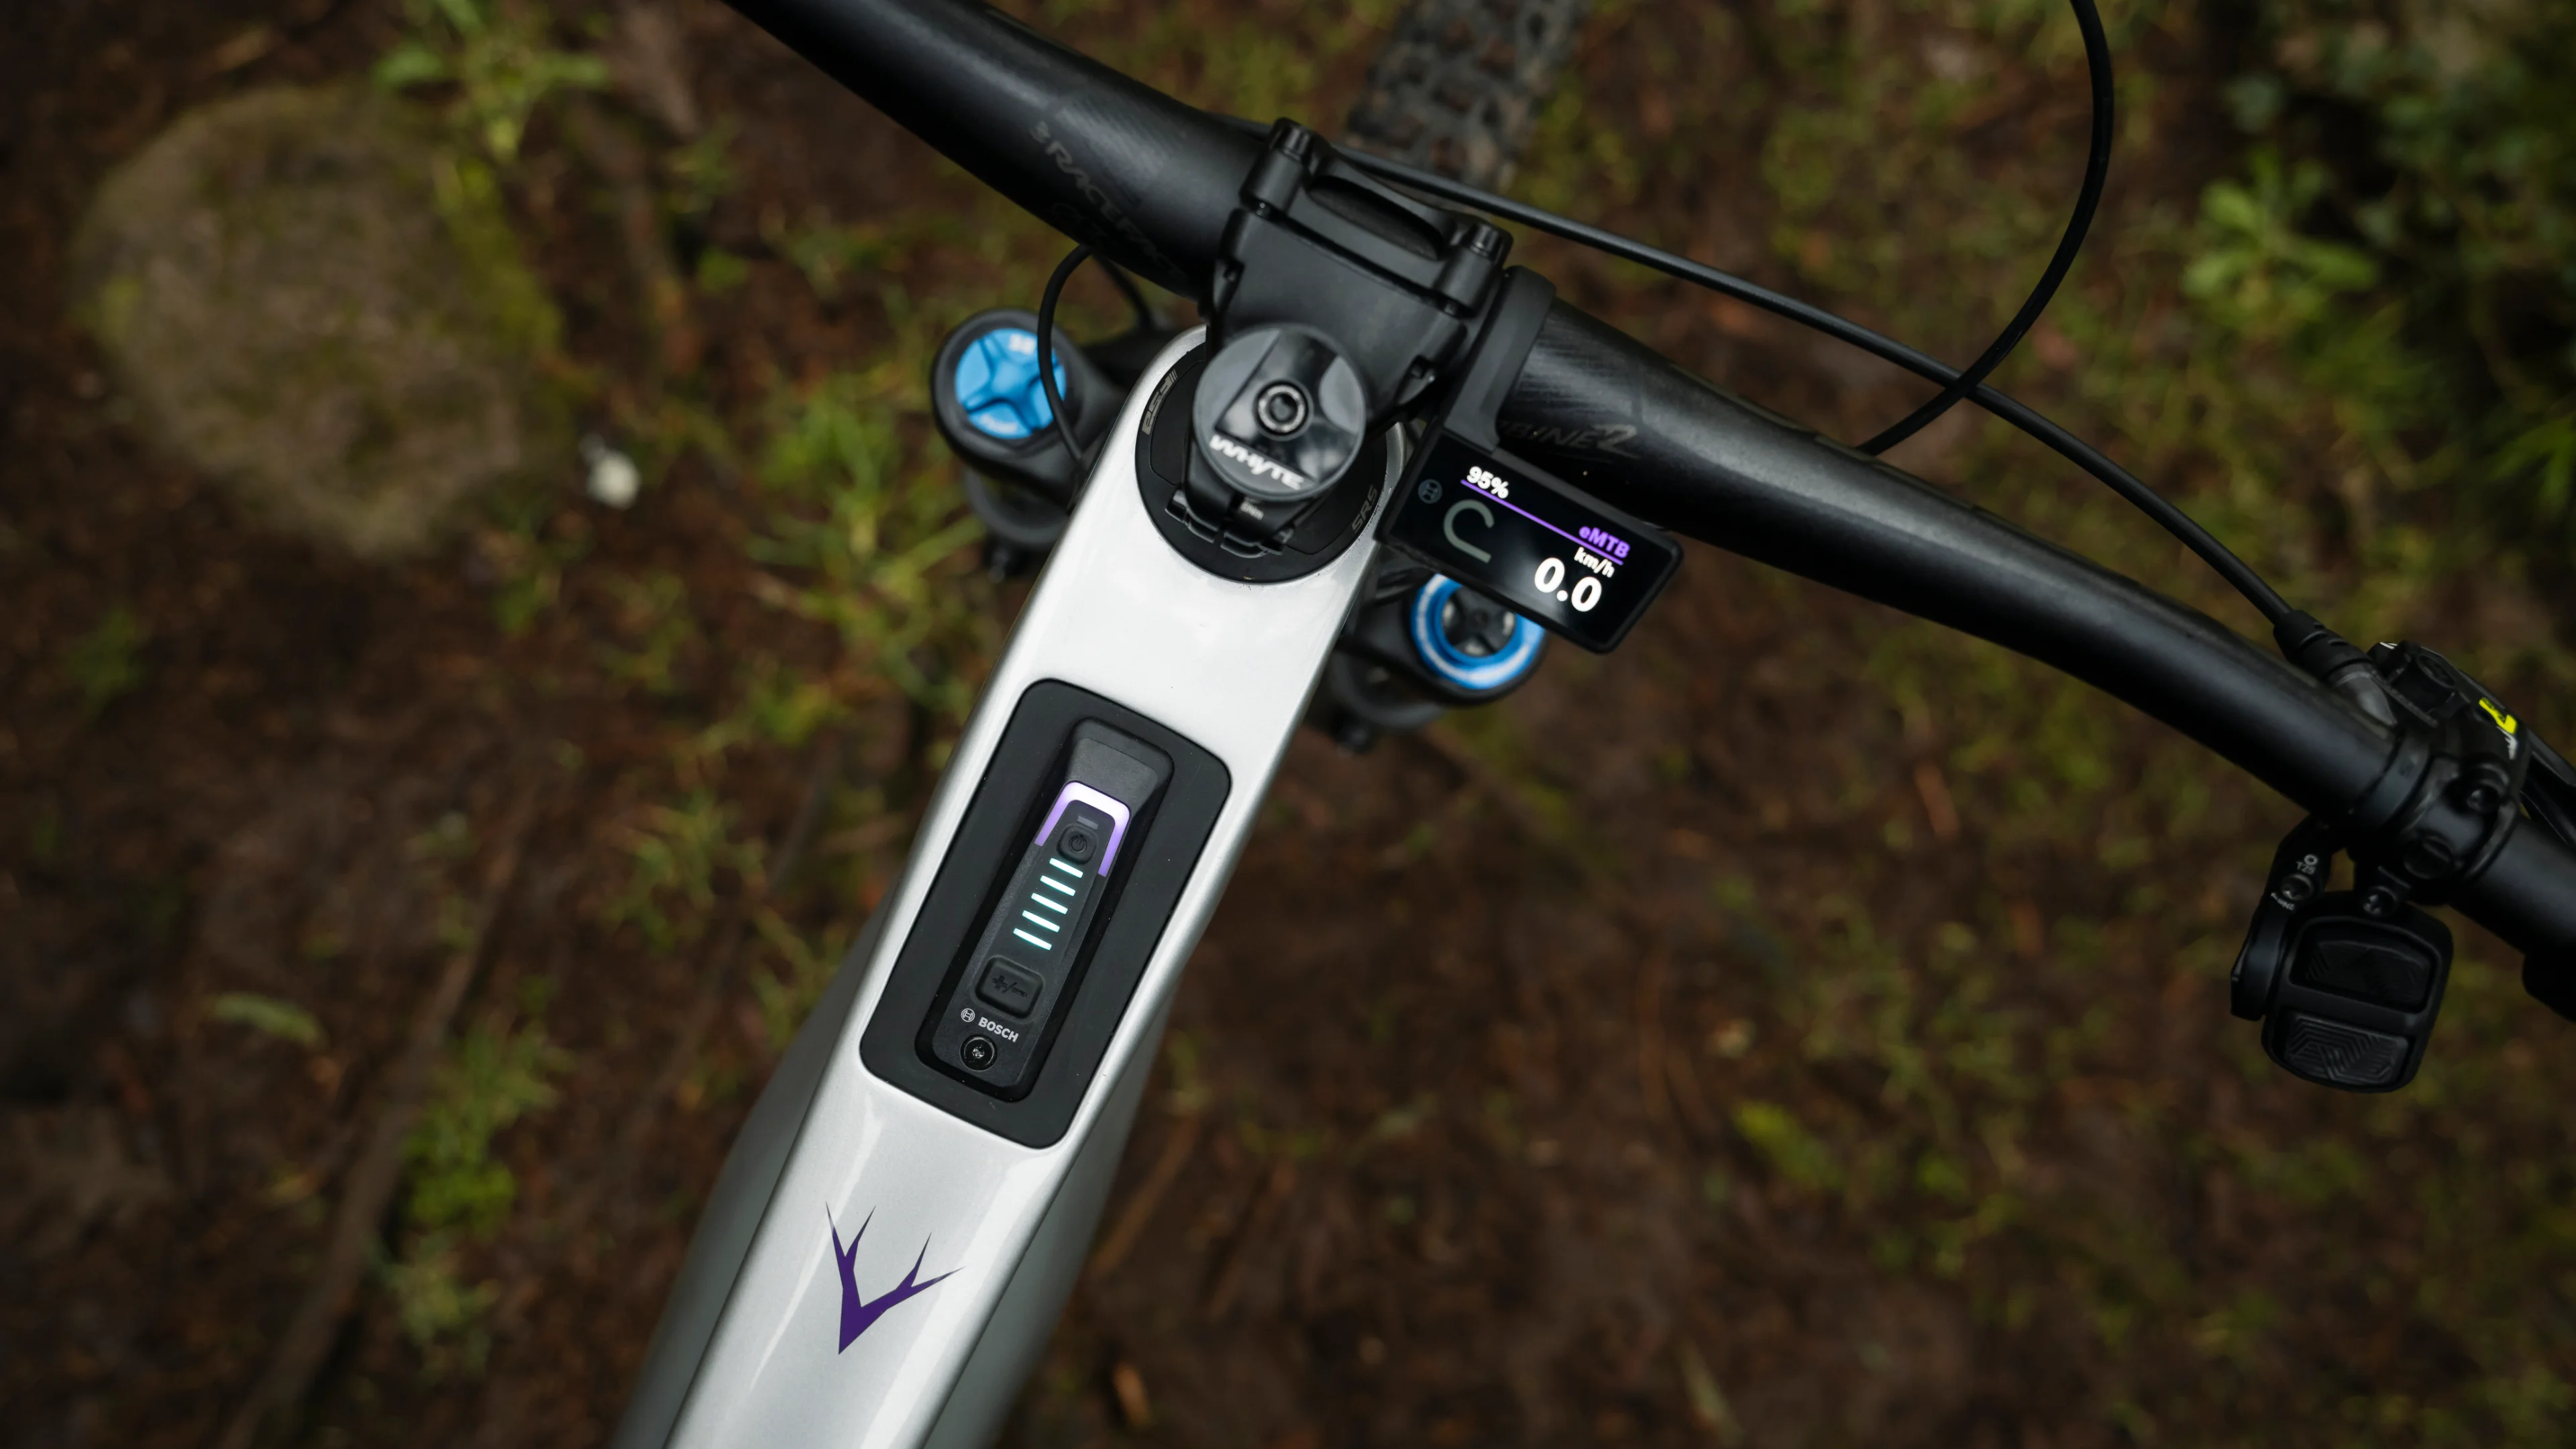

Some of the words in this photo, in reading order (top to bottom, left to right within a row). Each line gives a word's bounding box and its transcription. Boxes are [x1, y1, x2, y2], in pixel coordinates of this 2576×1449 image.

[1210, 435, 1305, 490] WHYTE
[1466, 466, 1509, 498] 95%
[1578, 526, 1630, 558] eMTB
[1574, 547, 1615, 578] km/h
[1534, 557, 1602, 612] 0.0
[978, 1016, 1019, 1042] BOSCH
